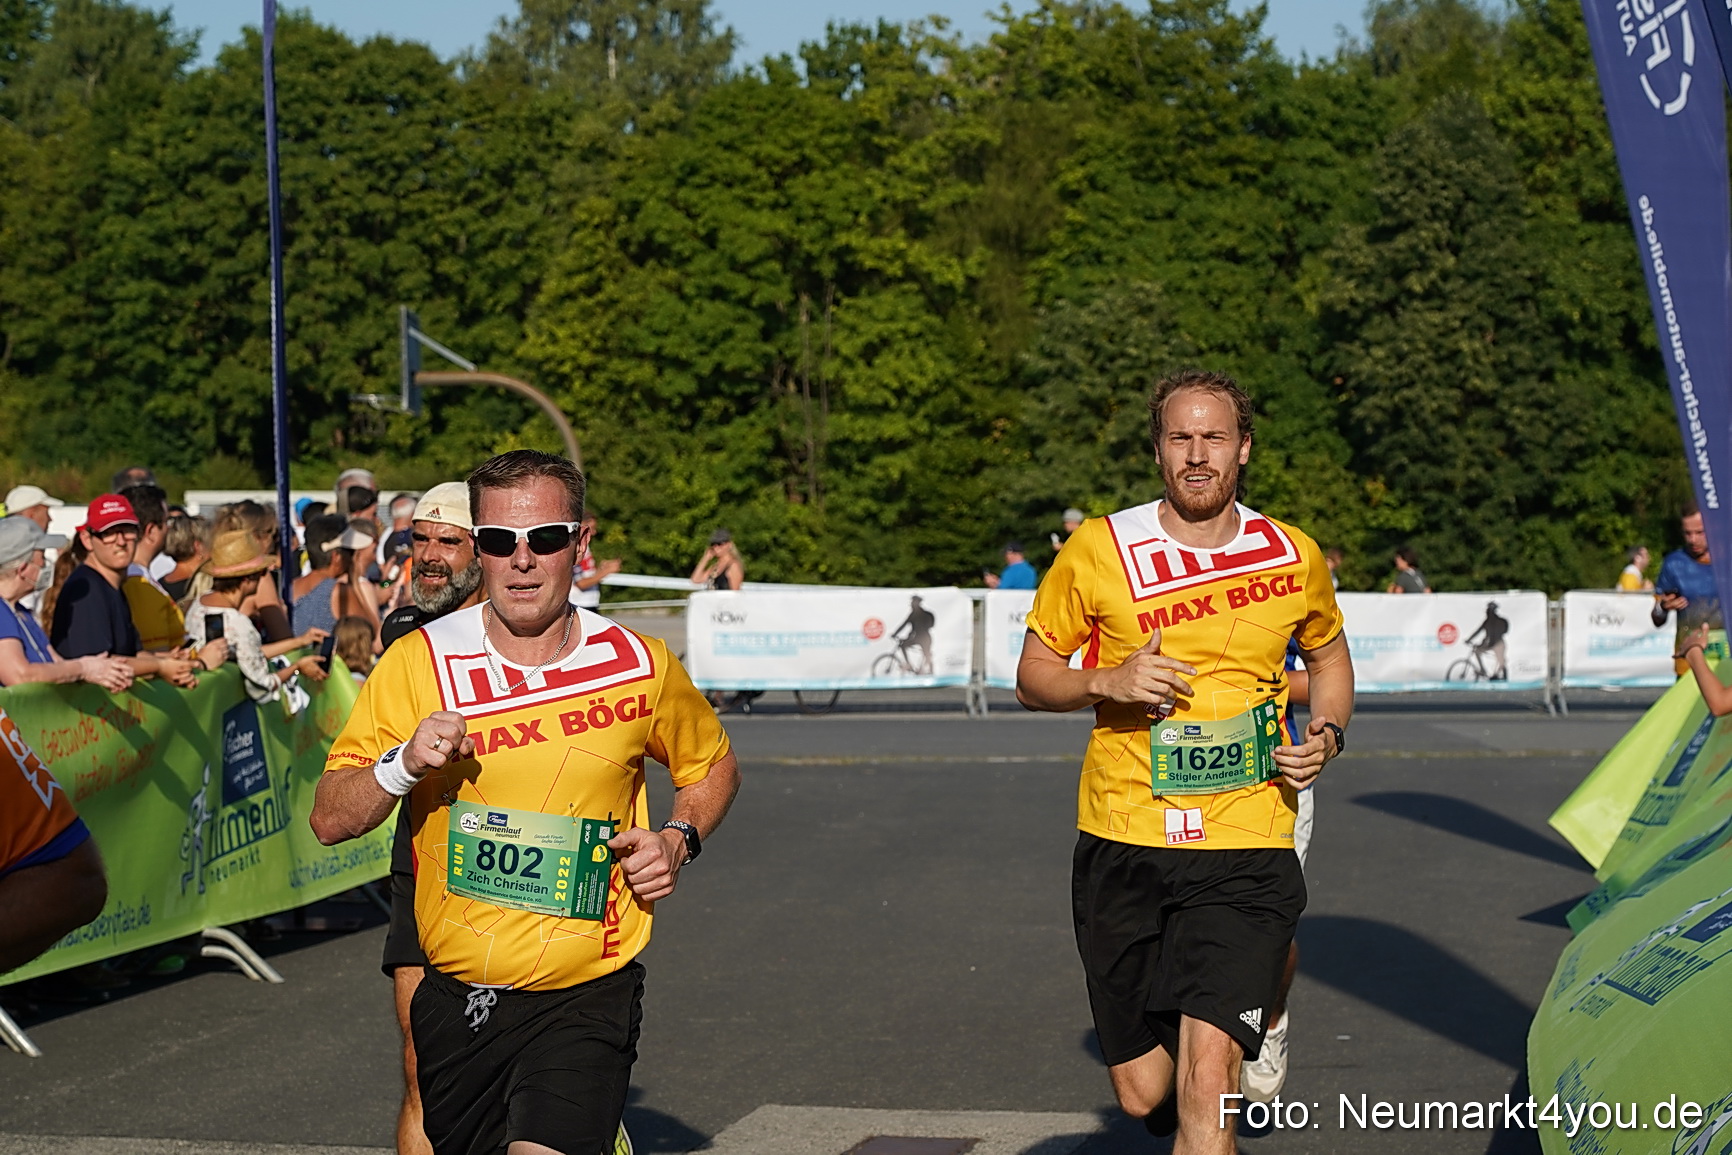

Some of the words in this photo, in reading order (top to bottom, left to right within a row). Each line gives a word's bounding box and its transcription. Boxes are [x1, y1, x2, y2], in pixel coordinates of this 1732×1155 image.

[1137, 594, 1218, 634] MAX
[1226, 574, 1303, 610] BÖGL
[559, 694, 653, 737] BÖGL
[1179, 733, 1214, 741] Firmenlauf
[1157, 753, 1168, 780] RUN
[1170, 742, 1243, 771] 1629
[1244, 741, 1255, 777] 2022
[1168, 772, 1202, 783] Stigler
[1204, 768, 1245, 781] Andreas
[480, 824, 522, 835] Firmenlauf
[495, 832, 521, 840] neumarkt
[453, 843, 465, 877] RUN
[476, 840, 544, 880] 802
[466, 870, 491, 886] Zich
[493, 876, 549, 895] Christian
[554, 856, 571, 902] 2022
[1239, 1012, 1261, 1034] adidas
